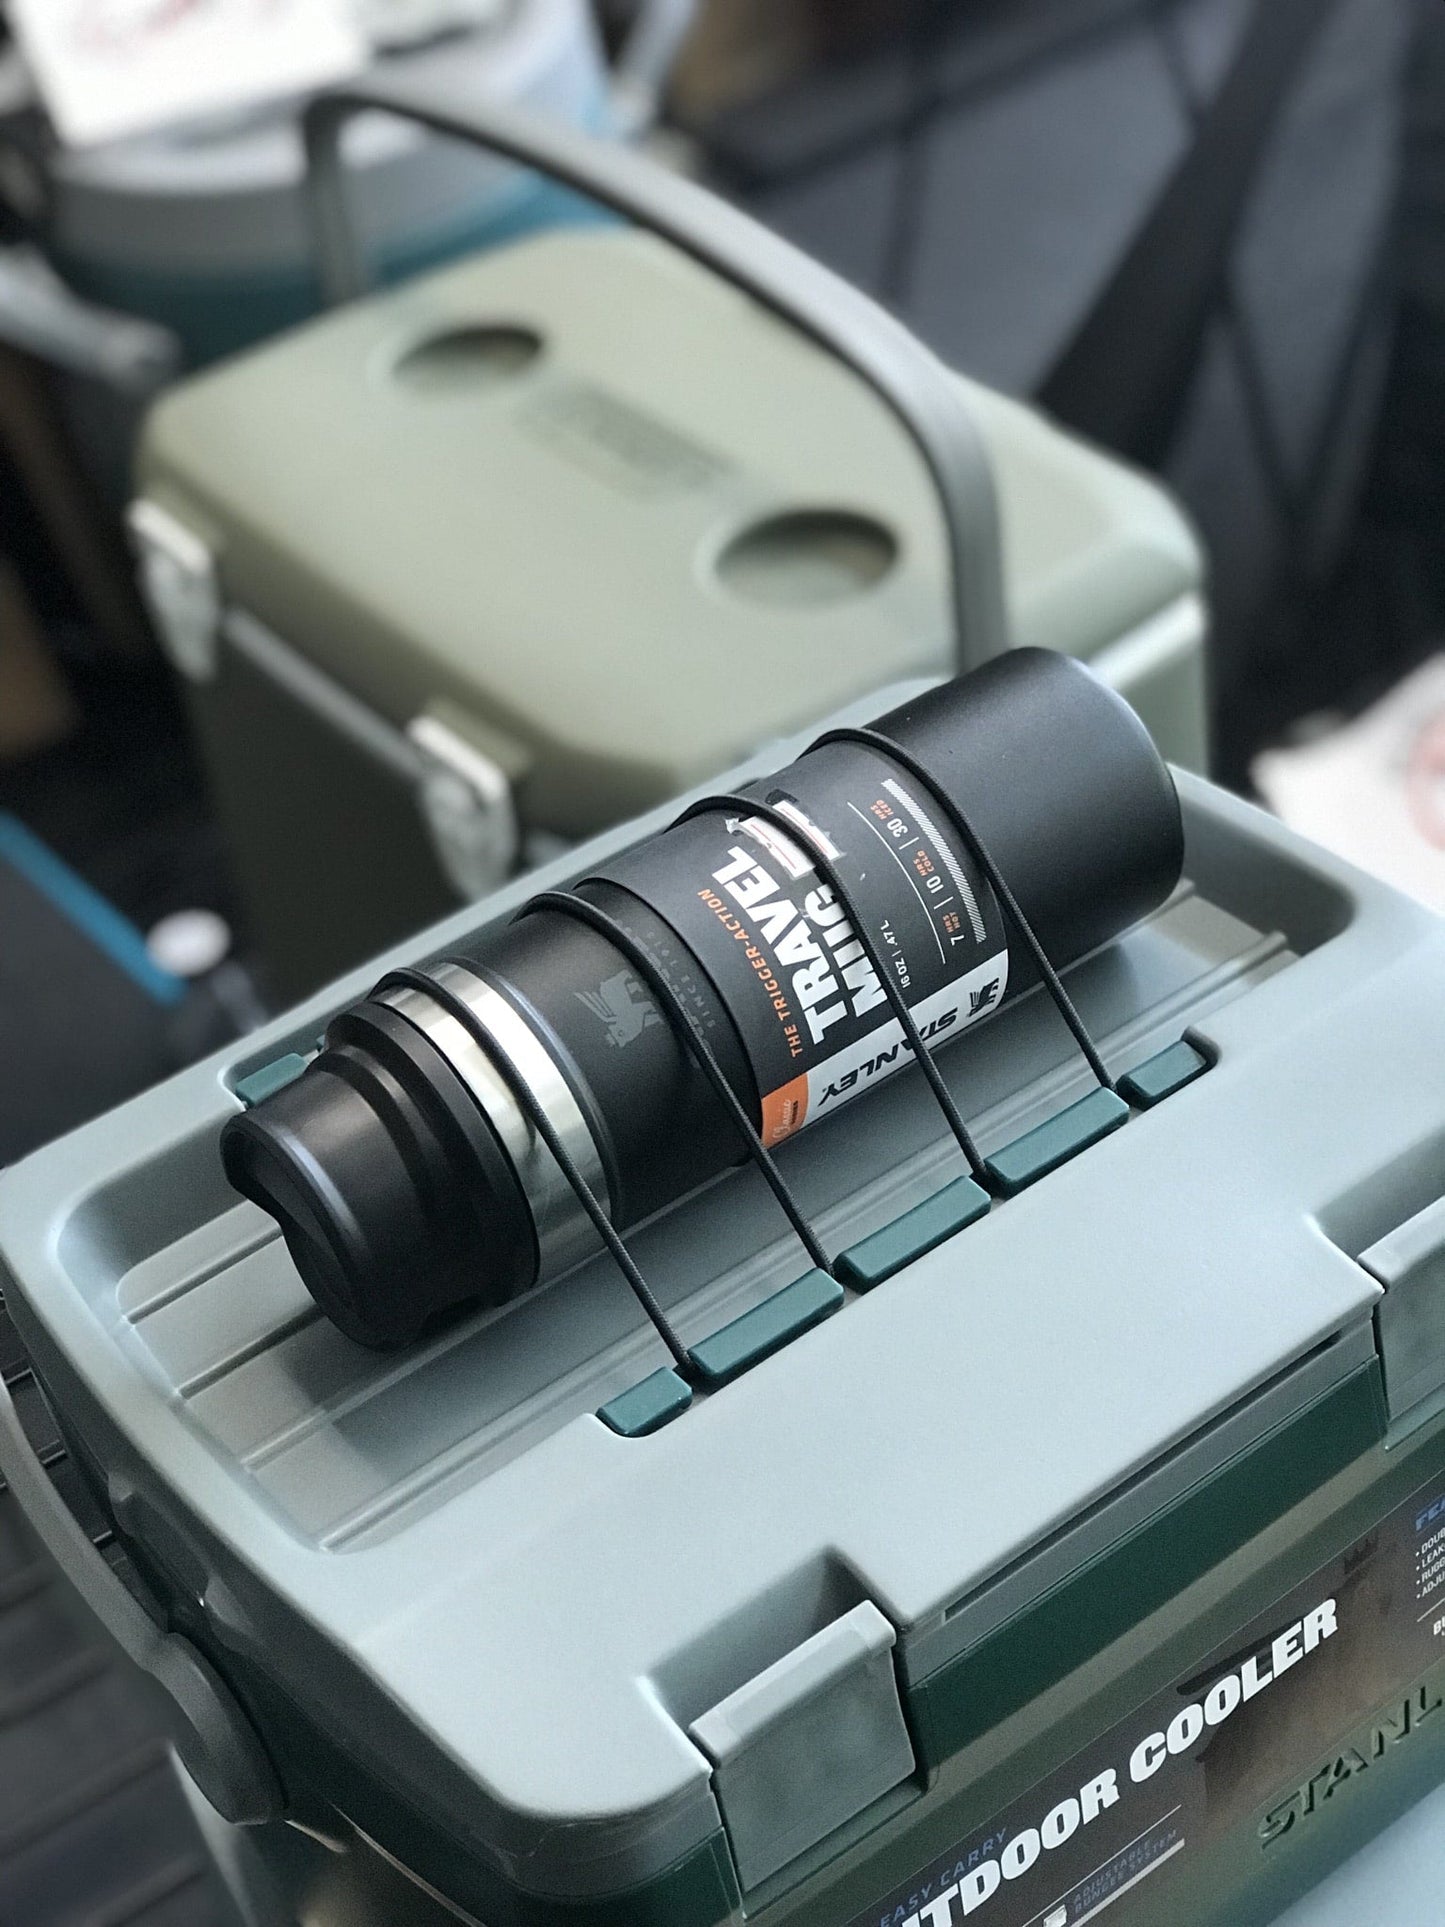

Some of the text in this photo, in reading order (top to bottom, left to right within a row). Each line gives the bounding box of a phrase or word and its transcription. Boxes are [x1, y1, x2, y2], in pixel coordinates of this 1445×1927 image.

[887, 818, 908, 838] 30
[913, 858, 944, 894] 10 HRS
[917, 850, 935, 873] COLD
[711, 846, 848, 1045] TRAVEL
[949, 934, 965, 946] 7
[697, 888, 803, 1058] THE TRIGGER-ACTION
[900, 973, 911, 988] 16
[901, 1599, 1338, 1927] TDOOR COOLER
[940, 1827, 1006, 1887] CARRY
